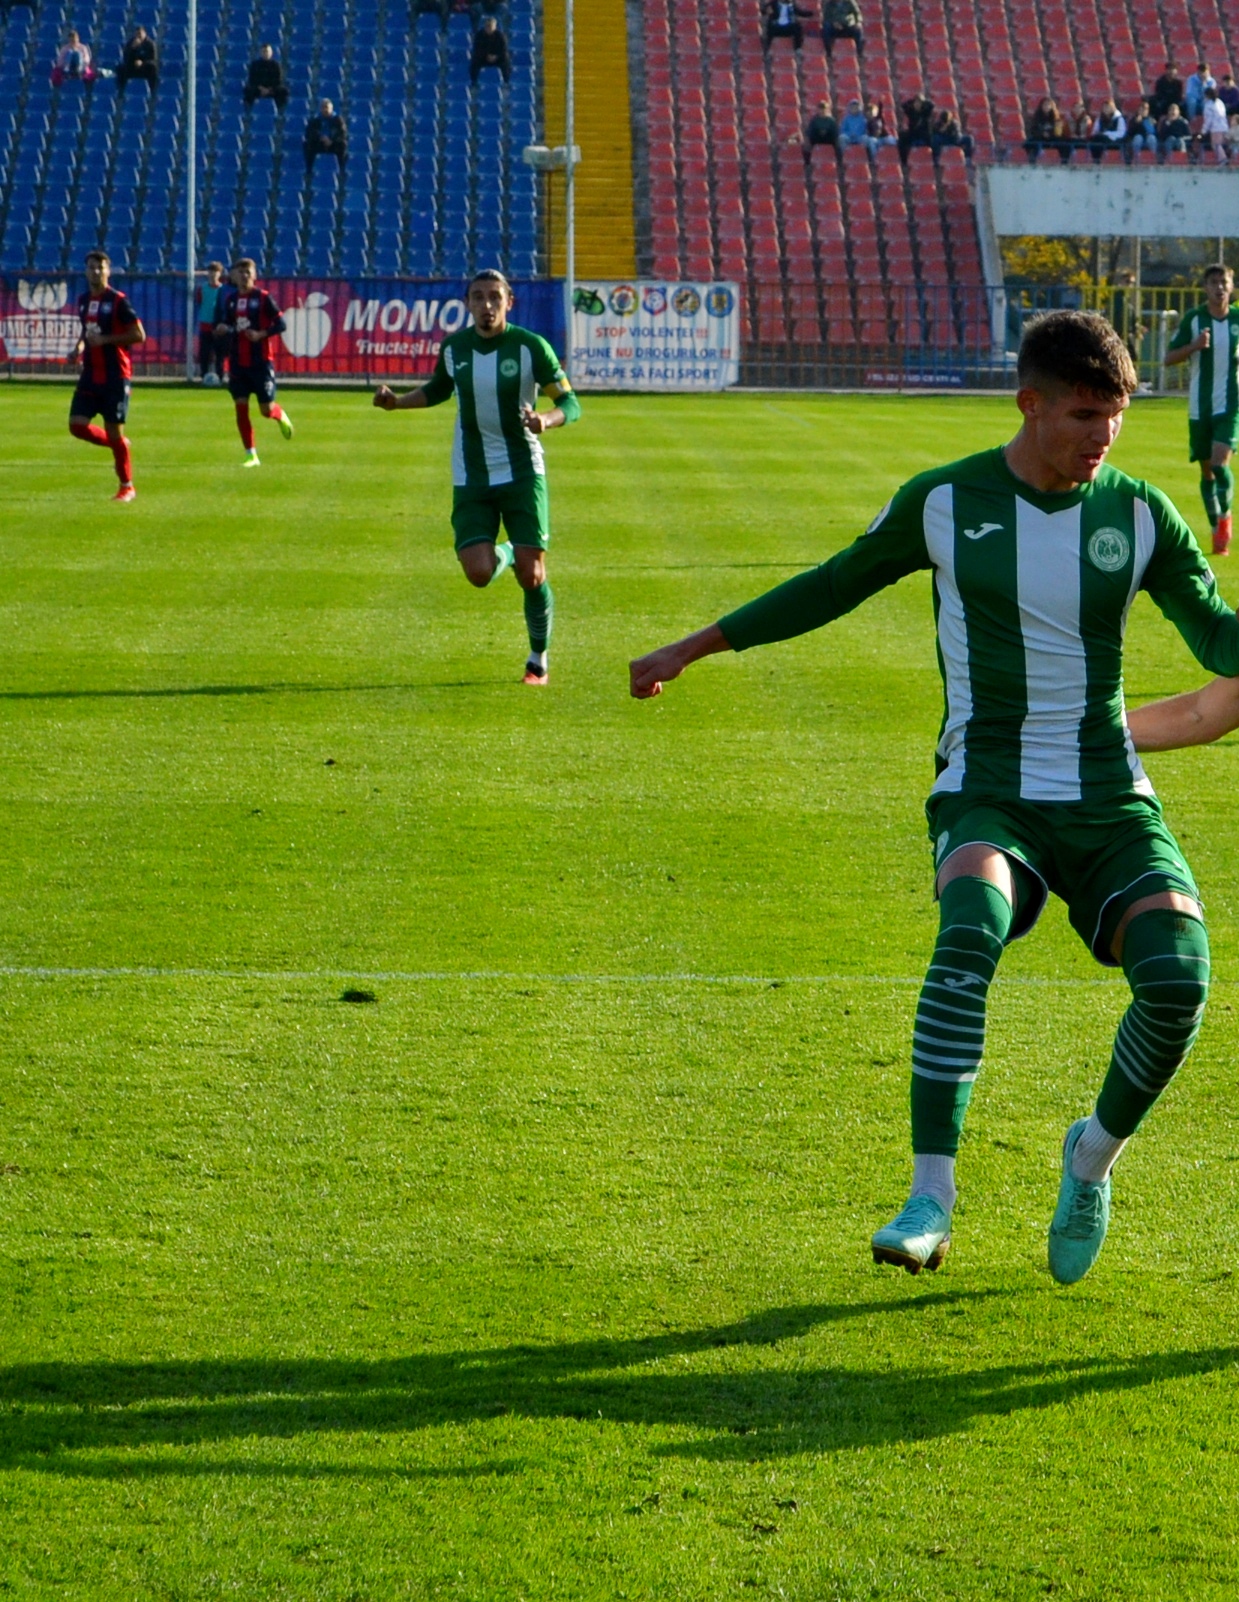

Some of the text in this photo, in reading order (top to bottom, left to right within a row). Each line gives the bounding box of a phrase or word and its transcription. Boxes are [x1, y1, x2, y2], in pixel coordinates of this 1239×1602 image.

[343, 299, 475, 332] MONO
[596, 327, 626, 338] STOP
[356, 338, 408, 354] Fructe
[616, 348, 633, 358] NU
[649, 367, 675, 379] FACI
[678, 367, 718, 379] SPORT
